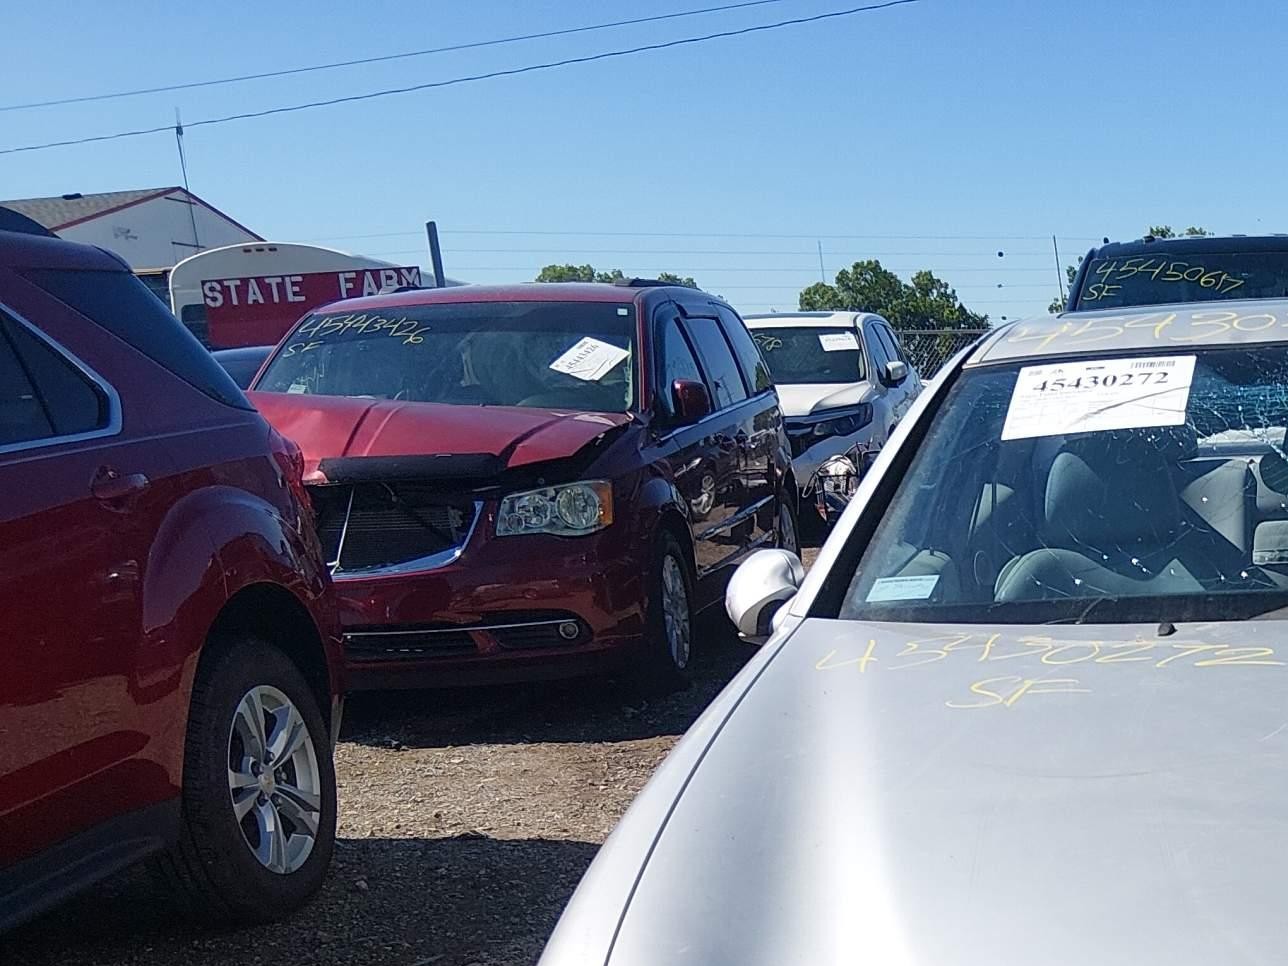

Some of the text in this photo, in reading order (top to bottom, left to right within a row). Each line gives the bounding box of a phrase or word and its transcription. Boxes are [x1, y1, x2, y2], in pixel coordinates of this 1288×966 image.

[203, 267, 422, 308] STATE FARM
[1082, 283, 1122, 301] SF
[1096, 258, 1245, 294] 45450617
[282, 340, 325, 358] SF
[1033, 371, 1170, 392] 45430272
[814, 632, 1288, 672] 45430272
[945, 675, 1093, 708] SF
